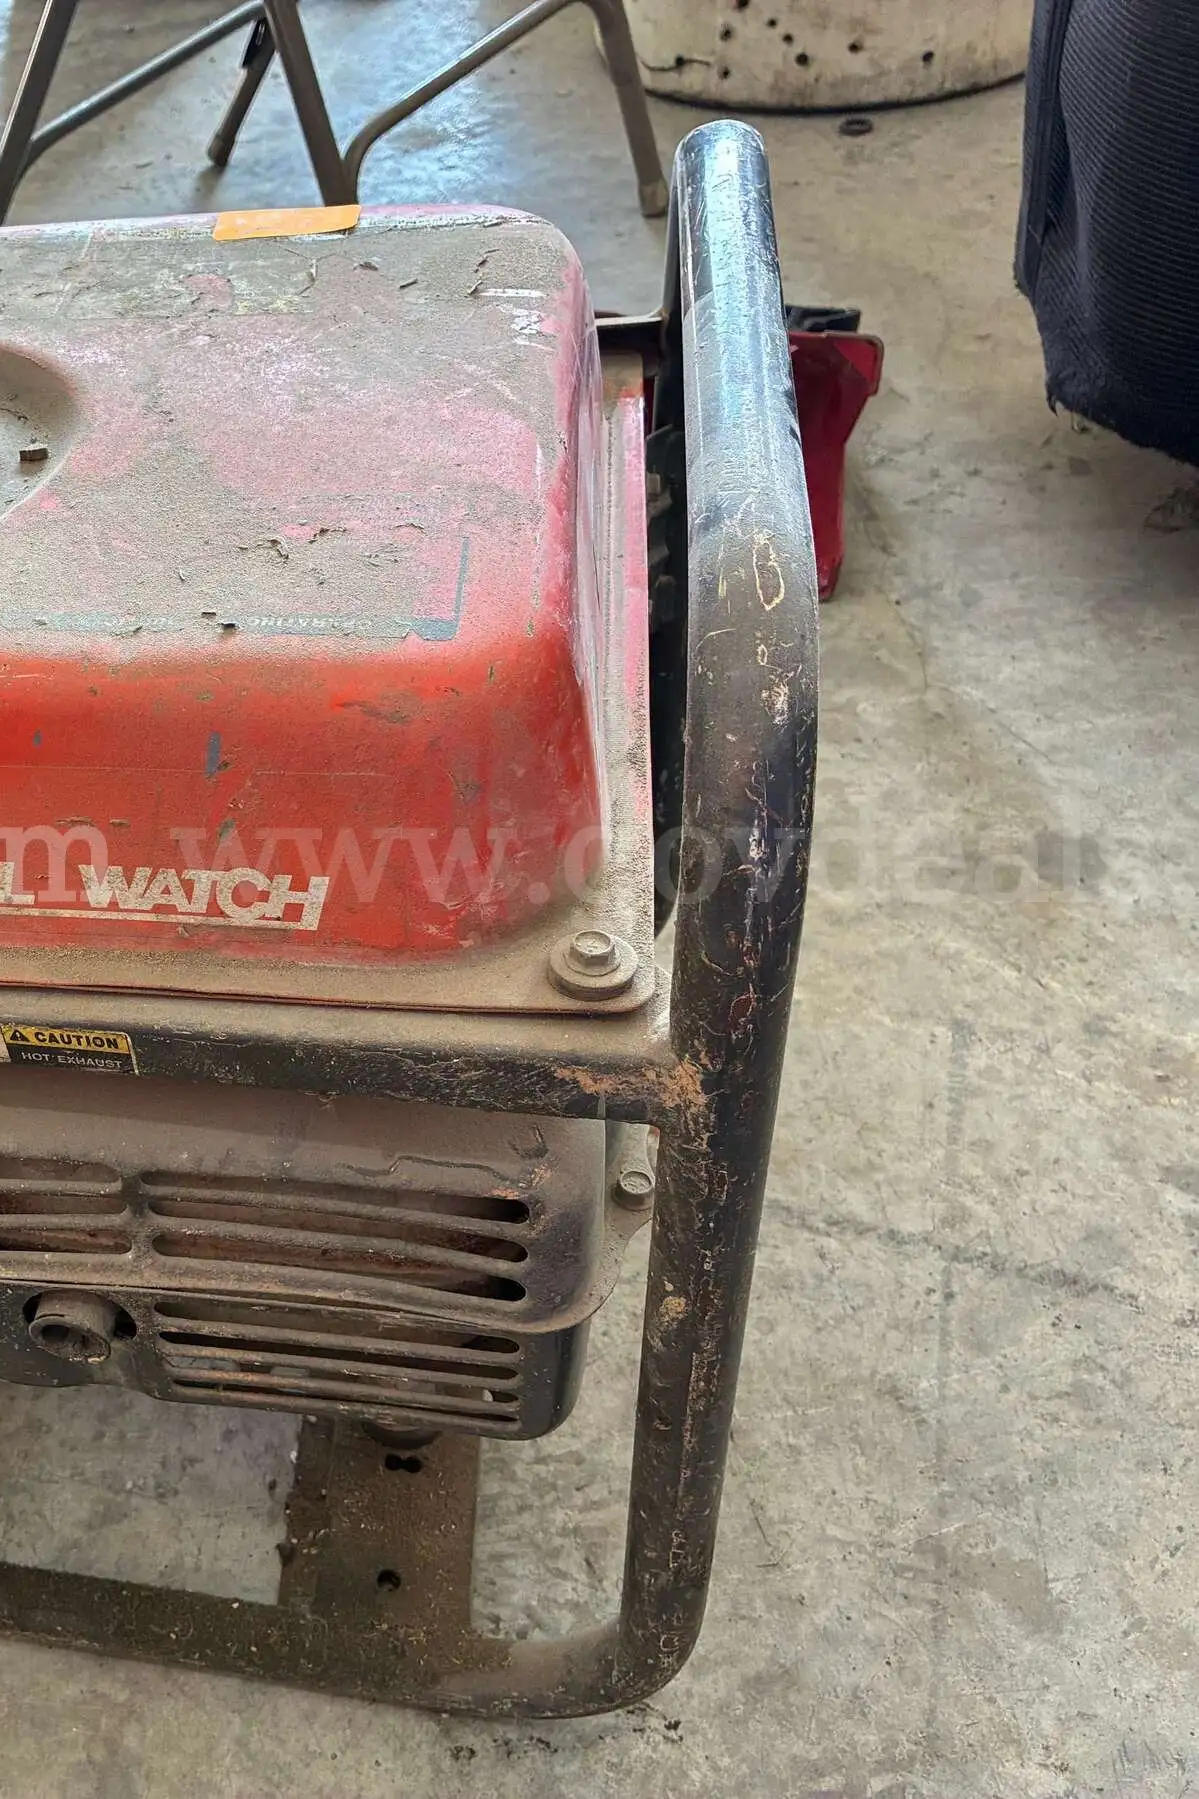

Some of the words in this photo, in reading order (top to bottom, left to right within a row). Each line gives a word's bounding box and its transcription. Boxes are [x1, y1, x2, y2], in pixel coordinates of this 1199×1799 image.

[79, 864, 330, 930] WATCH
[34, 1031, 119, 1049] CAUTION
[21, 1051, 50, 1063] HOT
[56, 1054, 123, 1069] EXHAUST
